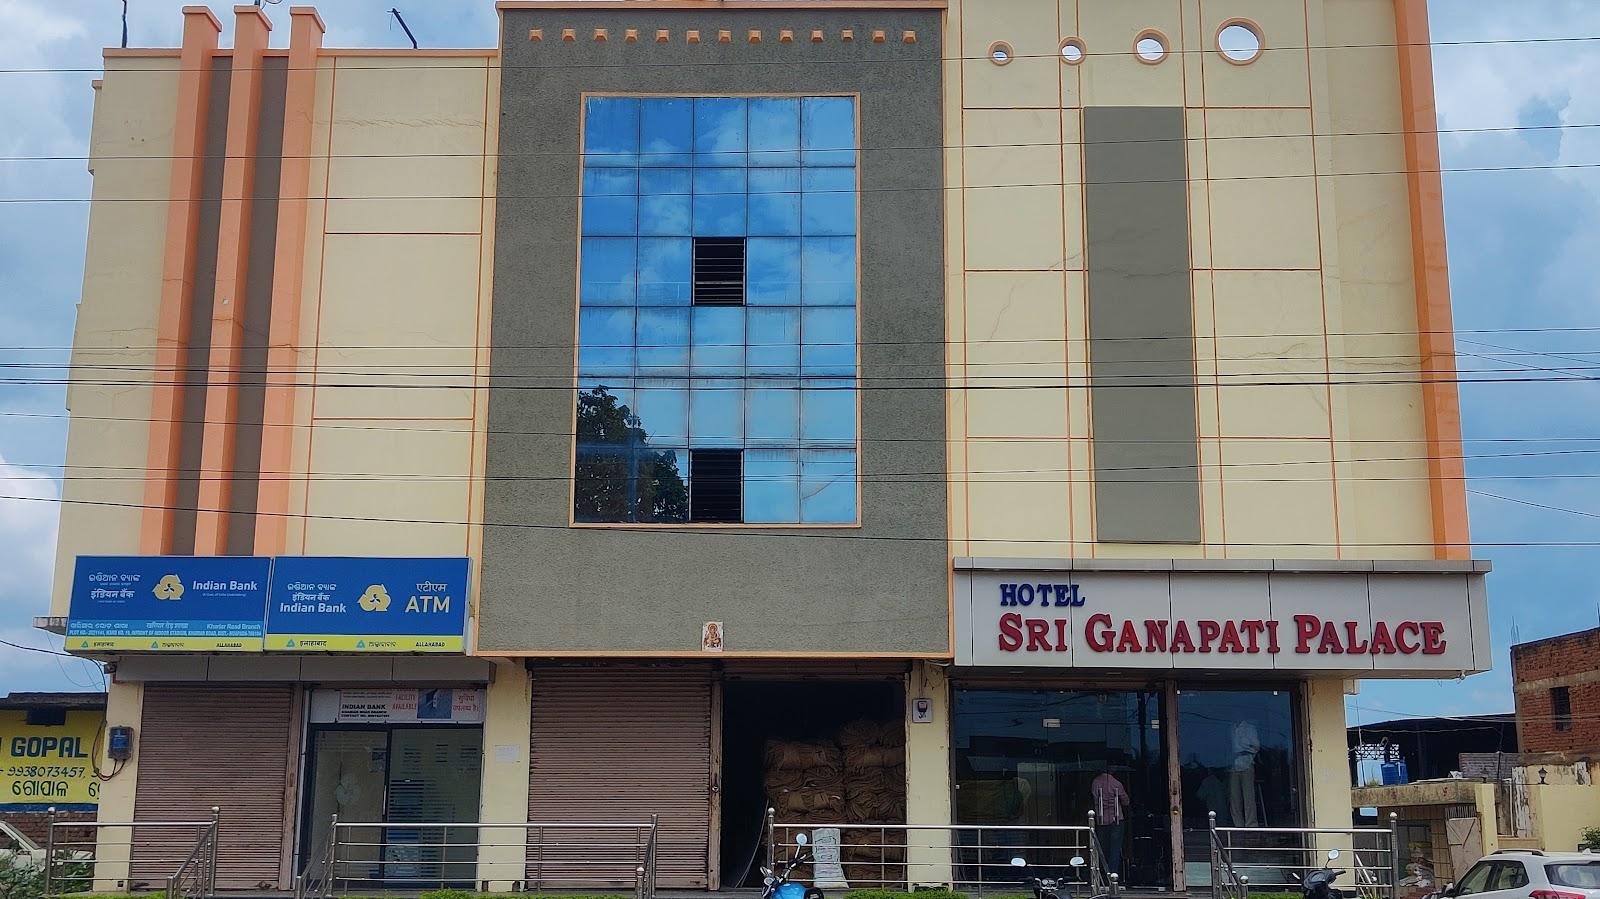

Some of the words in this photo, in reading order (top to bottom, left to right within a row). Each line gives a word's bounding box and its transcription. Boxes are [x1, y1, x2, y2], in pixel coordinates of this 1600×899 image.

[192, 581, 227, 590] Indian
[230, 581, 258, 590] Bank
[416, 581, 448, 592] एटीएम
[1000, 583, 1086, 607] HOTEL
[280, 603, 315, 613] Indian
[318, 603, 347, 613] Bank
[405, 596, 450, 613] ATM
[998, 613, 1069, 653] SRI
[1084, 613, 1281, 655] GANAPATI
[1294, 614, 1447, 656] PALACE
[10, 737, 88, 758] GOPAL
